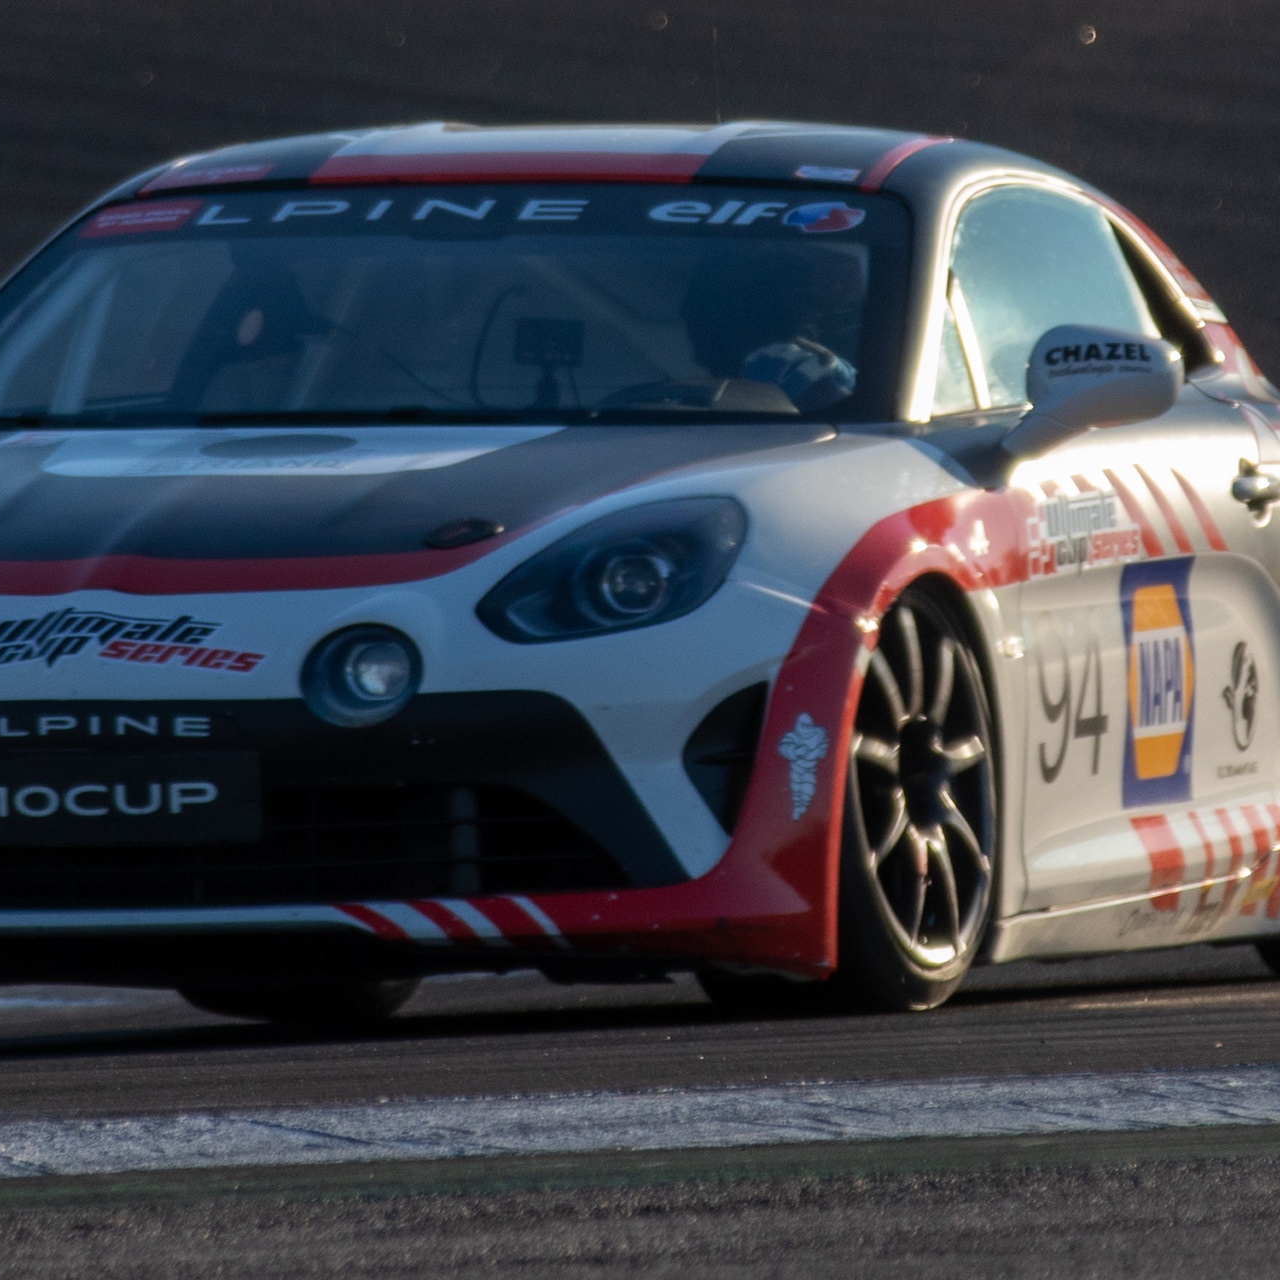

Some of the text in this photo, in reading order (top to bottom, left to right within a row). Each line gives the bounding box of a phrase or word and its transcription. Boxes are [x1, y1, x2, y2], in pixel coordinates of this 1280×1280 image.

[197, 199, 590, 227] LPINE
[648, 199, 790, 226] elf
[1045, 342, 1152, 366] CHAZEL
[1137, 635, 1184, 728] NAPA
[1036, 625, 1109, 785] 94
